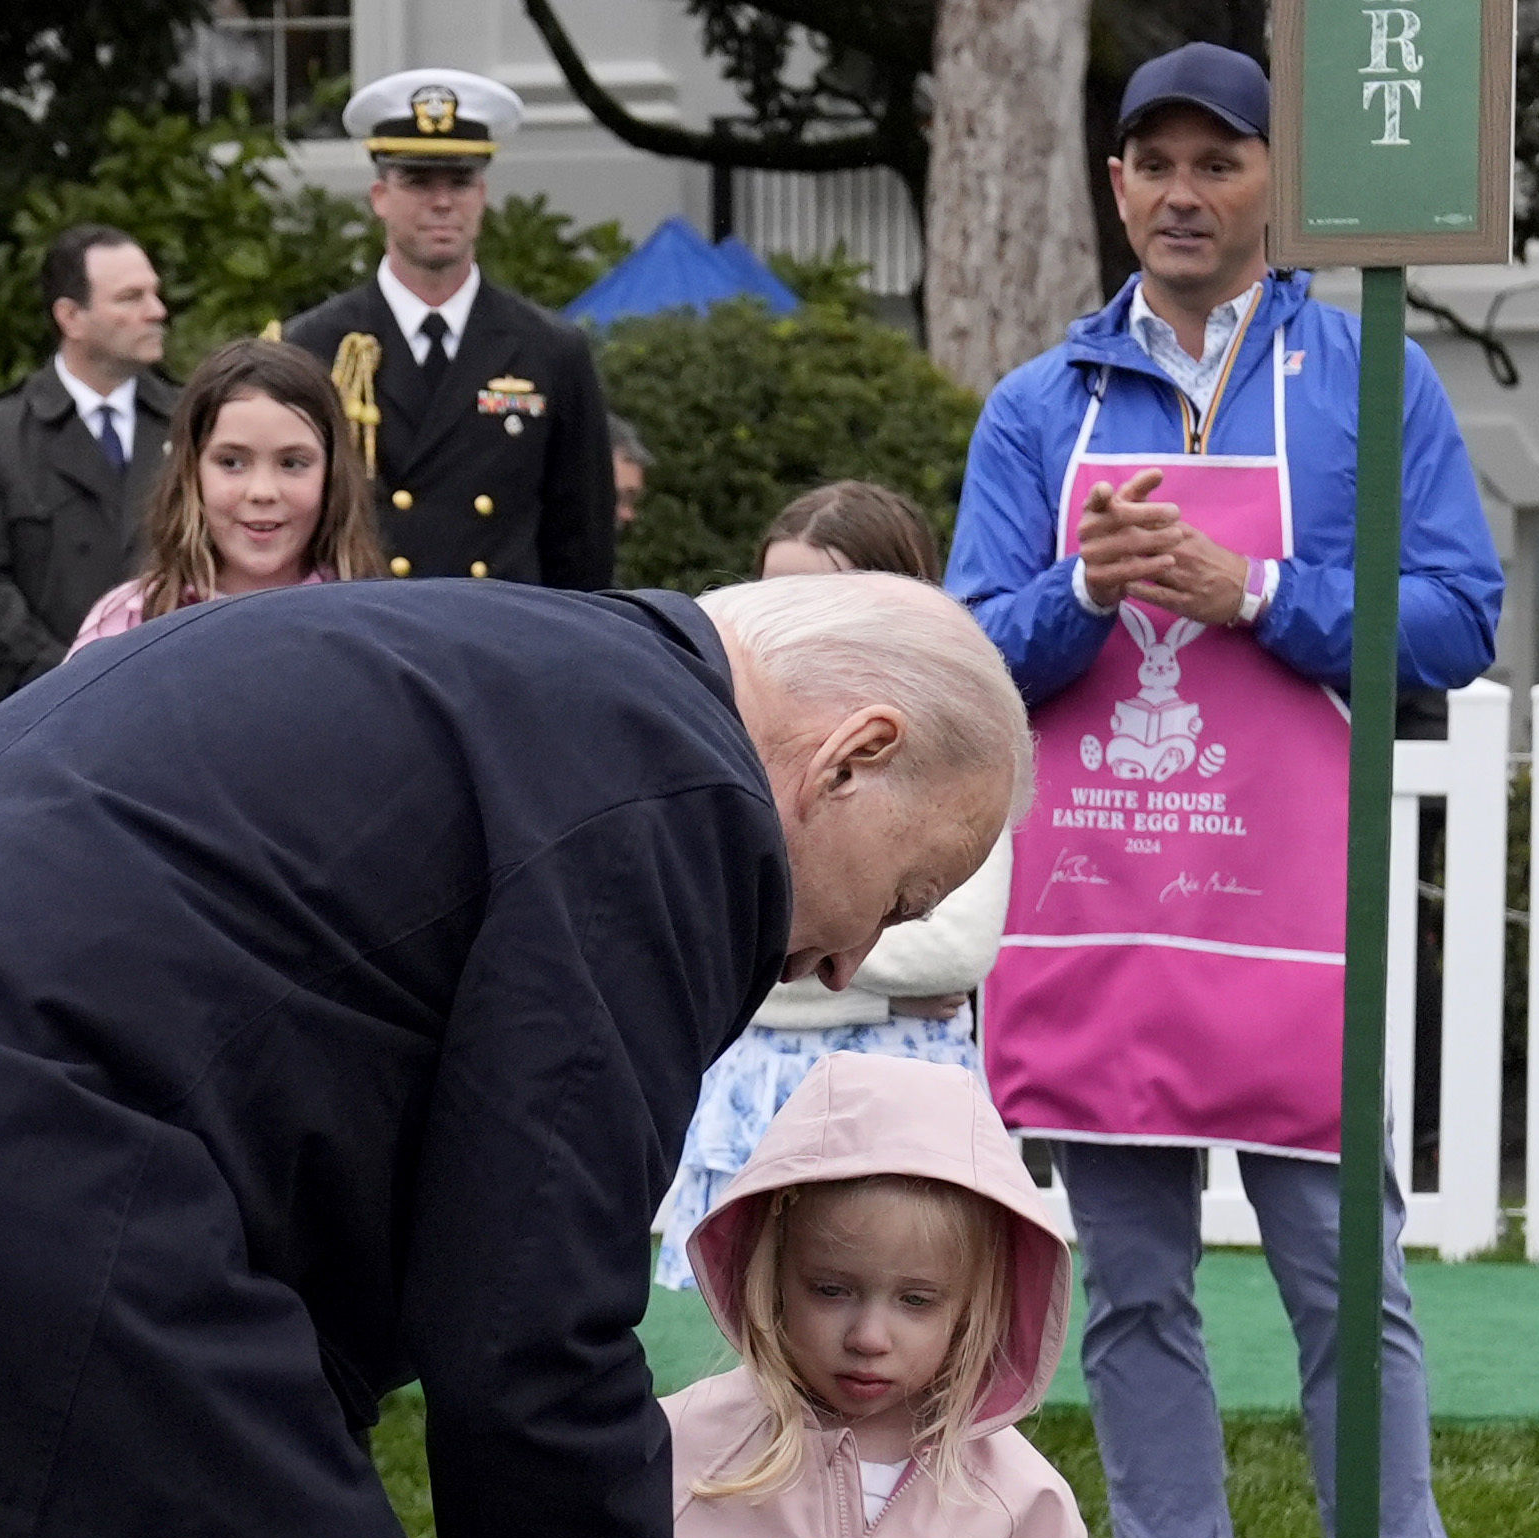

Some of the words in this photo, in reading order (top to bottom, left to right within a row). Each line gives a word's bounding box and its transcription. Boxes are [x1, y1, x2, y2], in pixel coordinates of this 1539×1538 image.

[1358, 0, 1424, 145] RT
[1071, 788, 1139, 809] WHITE
[1147, 791, 1227, 813] HOUSE
[1052, 808, 1126, 831] EASTER
[1134, 812, 1180, 832] EGG
[1188, 813, 1248, 836] ROLL
[1124, 837, 1162, 854] 2024
